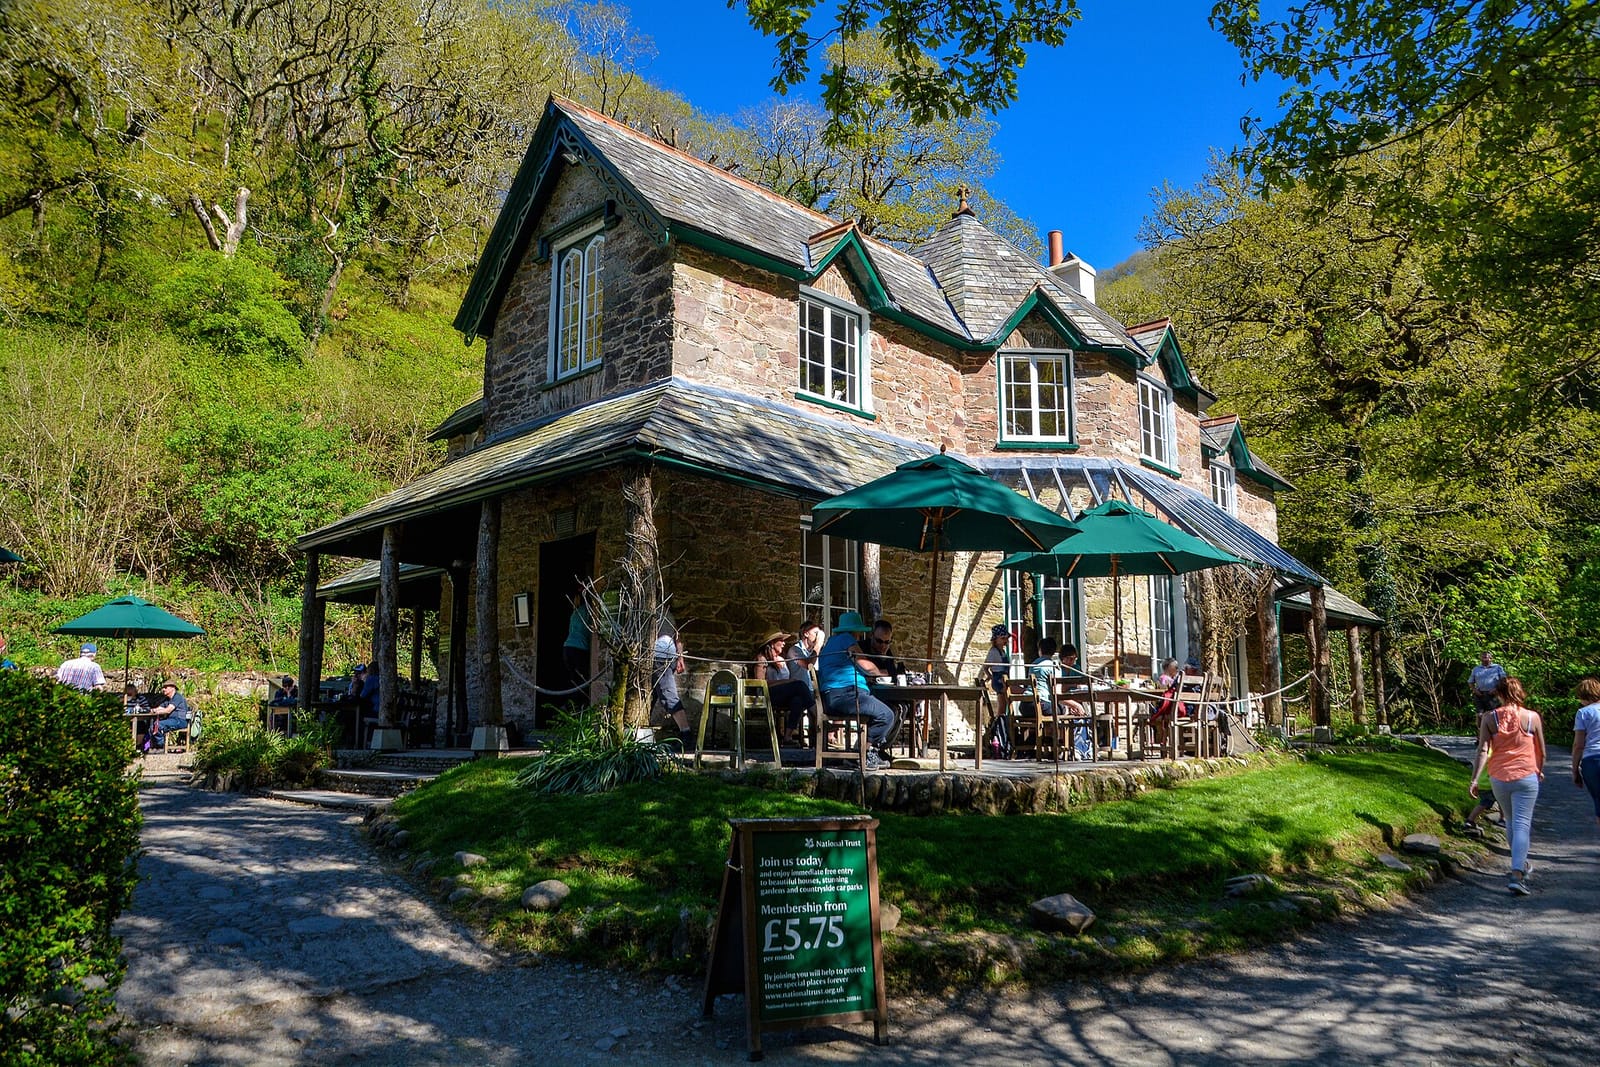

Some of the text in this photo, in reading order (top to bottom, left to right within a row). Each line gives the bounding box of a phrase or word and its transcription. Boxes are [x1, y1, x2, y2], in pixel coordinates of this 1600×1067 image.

[816, 839, 861, 848] National Trust
[760, 855, 823, 868] Join us today
[760, 870, 772, 878] and
[773, 870, 790, 878] enjoy
[791, 868, 824, 876] immediate
[798, 877, 821, 885] houses,
[822, 876, 849, 884] stunning
[760, 887, 785, 896] gardens
[799, 884, 835, 894] countryside
[846, 883, 863, 892] parks
[761, 900, 847, 915] Membership from
[763, 915, 844, 952] £5.75
[764, 973, 772, 981] By
[773, 971, 796, 981] joining
[809, 969, 821, 977] will
[821, 968, 835, 976] help
[844, 966, 866, 975] protect
[764, 982, 783, 990] these
[783, 979, 806, 988] special
[806, 978, 826, 987] places
[765, 986, 844, 1000] www.nationaltrust.org.uk
